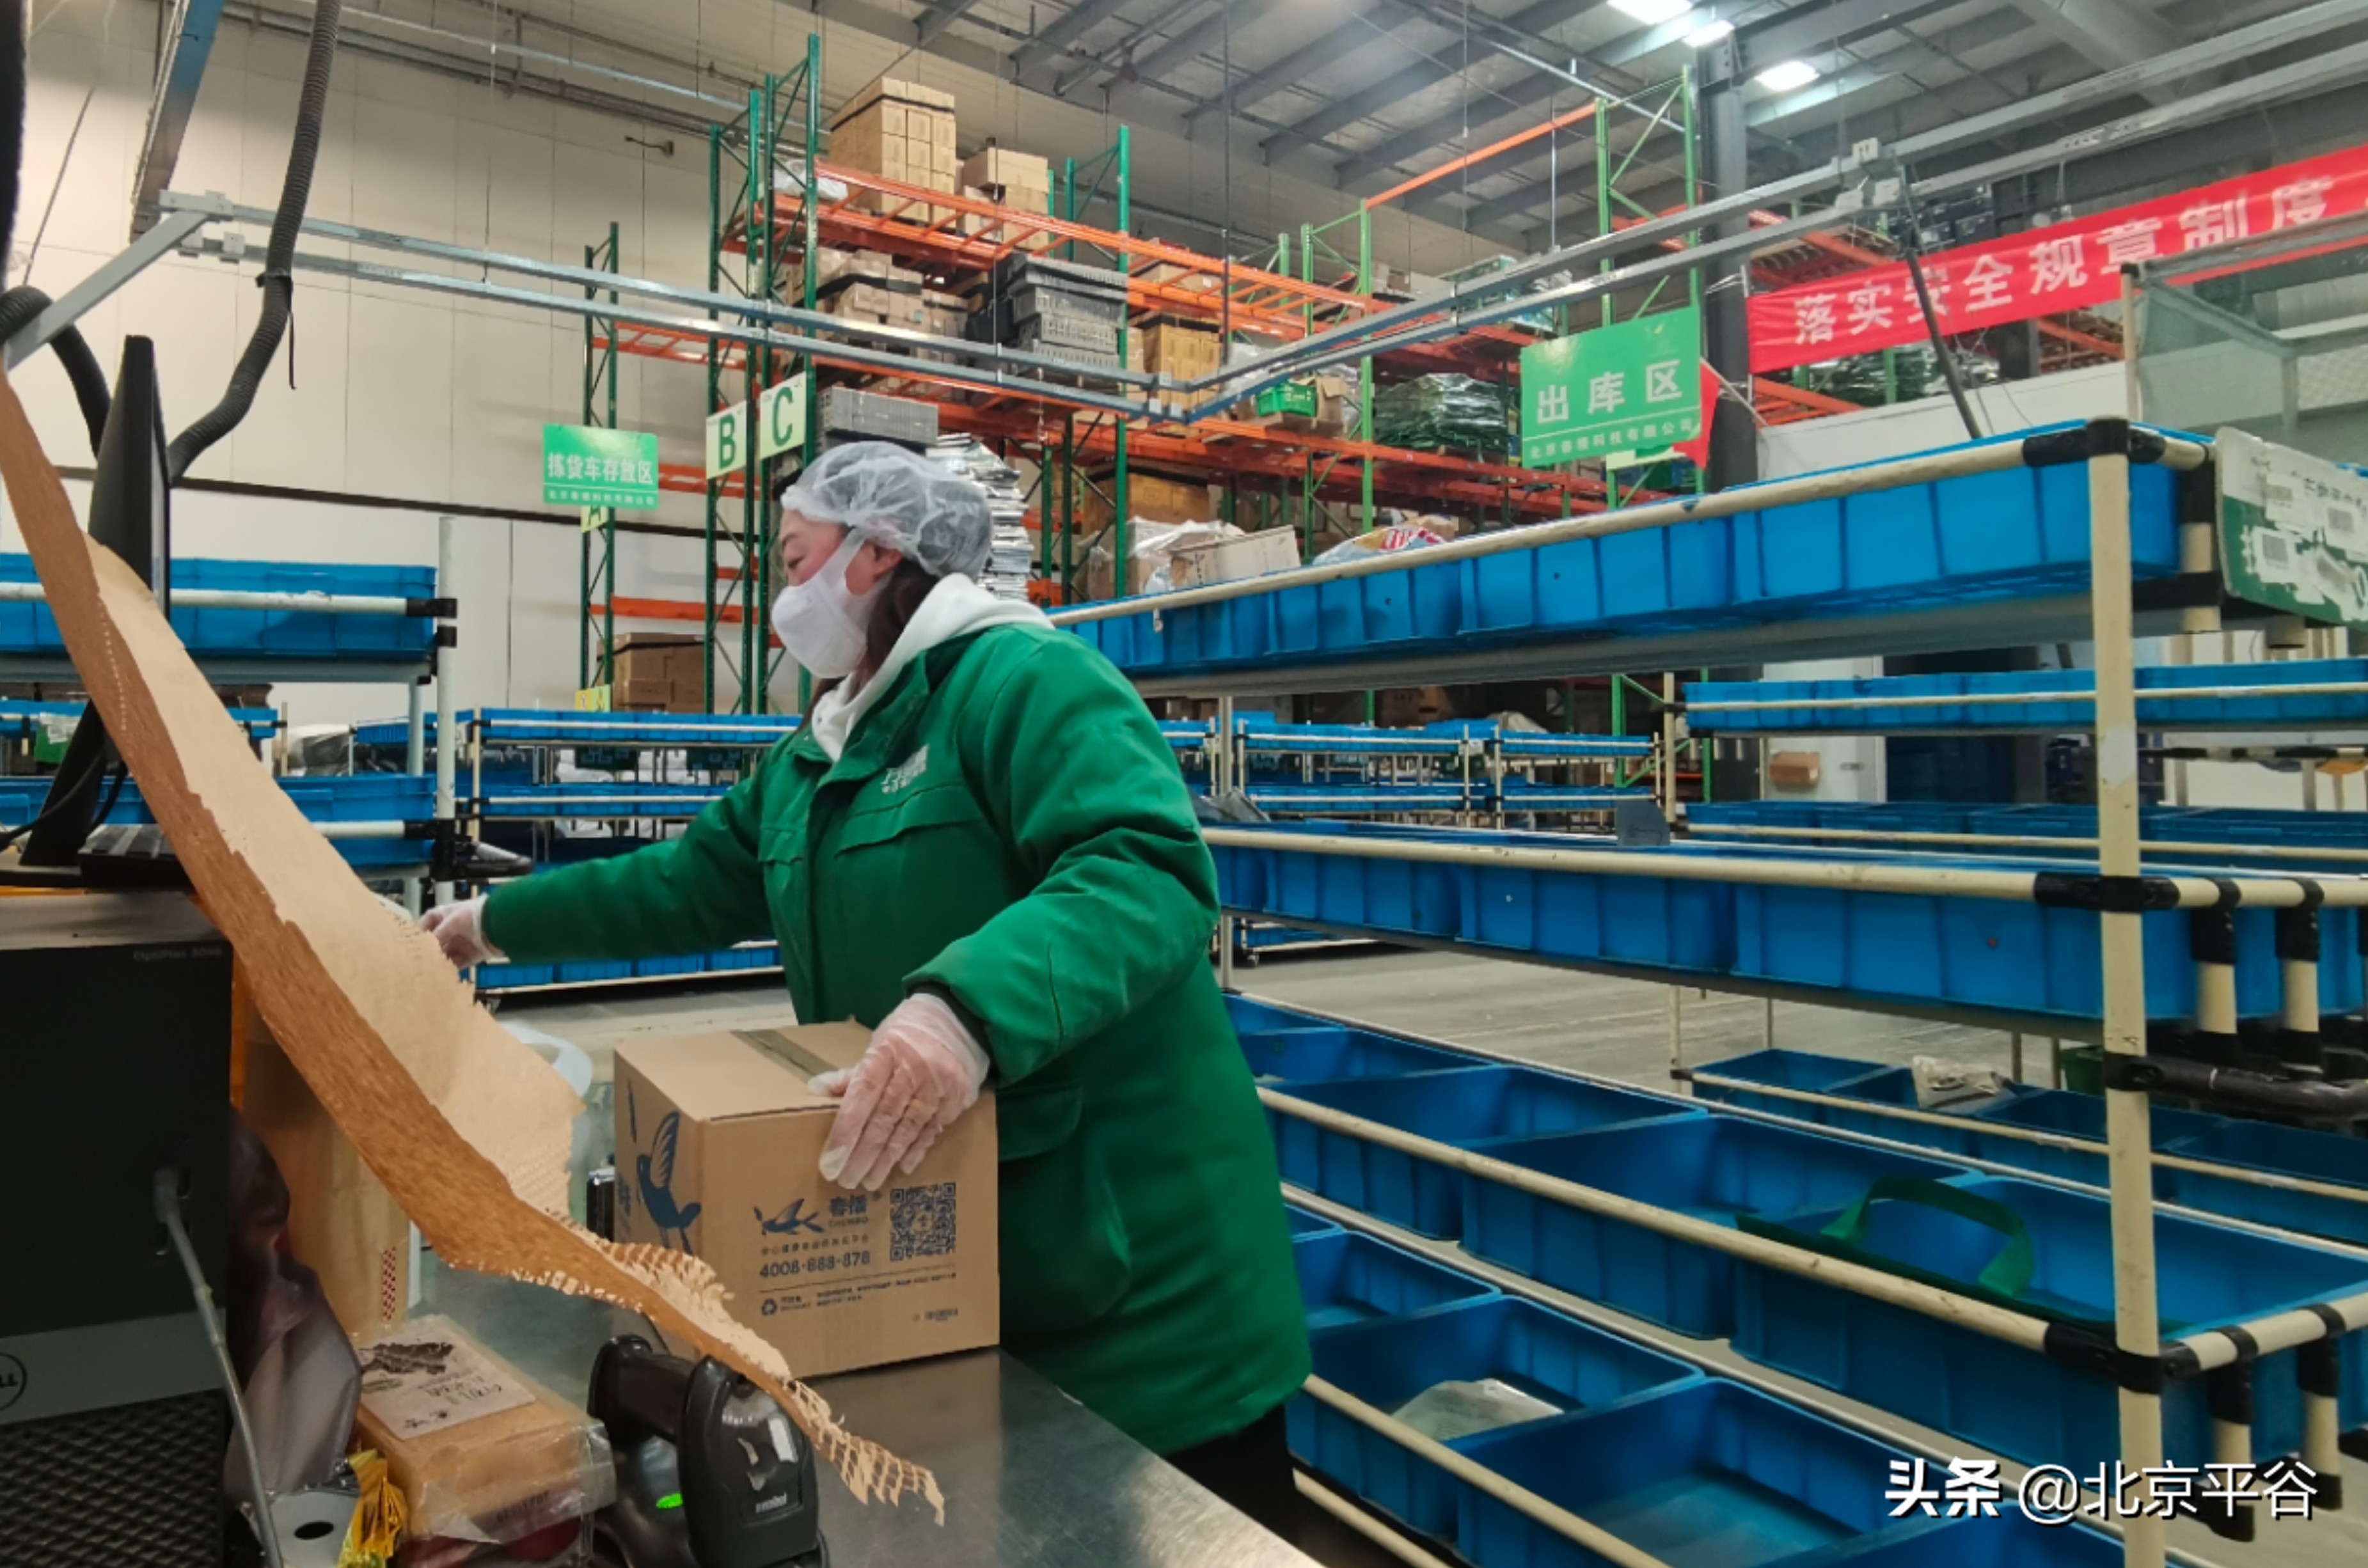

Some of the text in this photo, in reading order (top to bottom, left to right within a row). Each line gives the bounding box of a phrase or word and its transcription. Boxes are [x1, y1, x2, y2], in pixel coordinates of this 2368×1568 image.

[1793, 175, 2333, 345] 落实安全规章制度
[771, 386, 793, 448] C
[1537, 358, 1684, 424] 出库区
[718, 413, 736, 470] B
